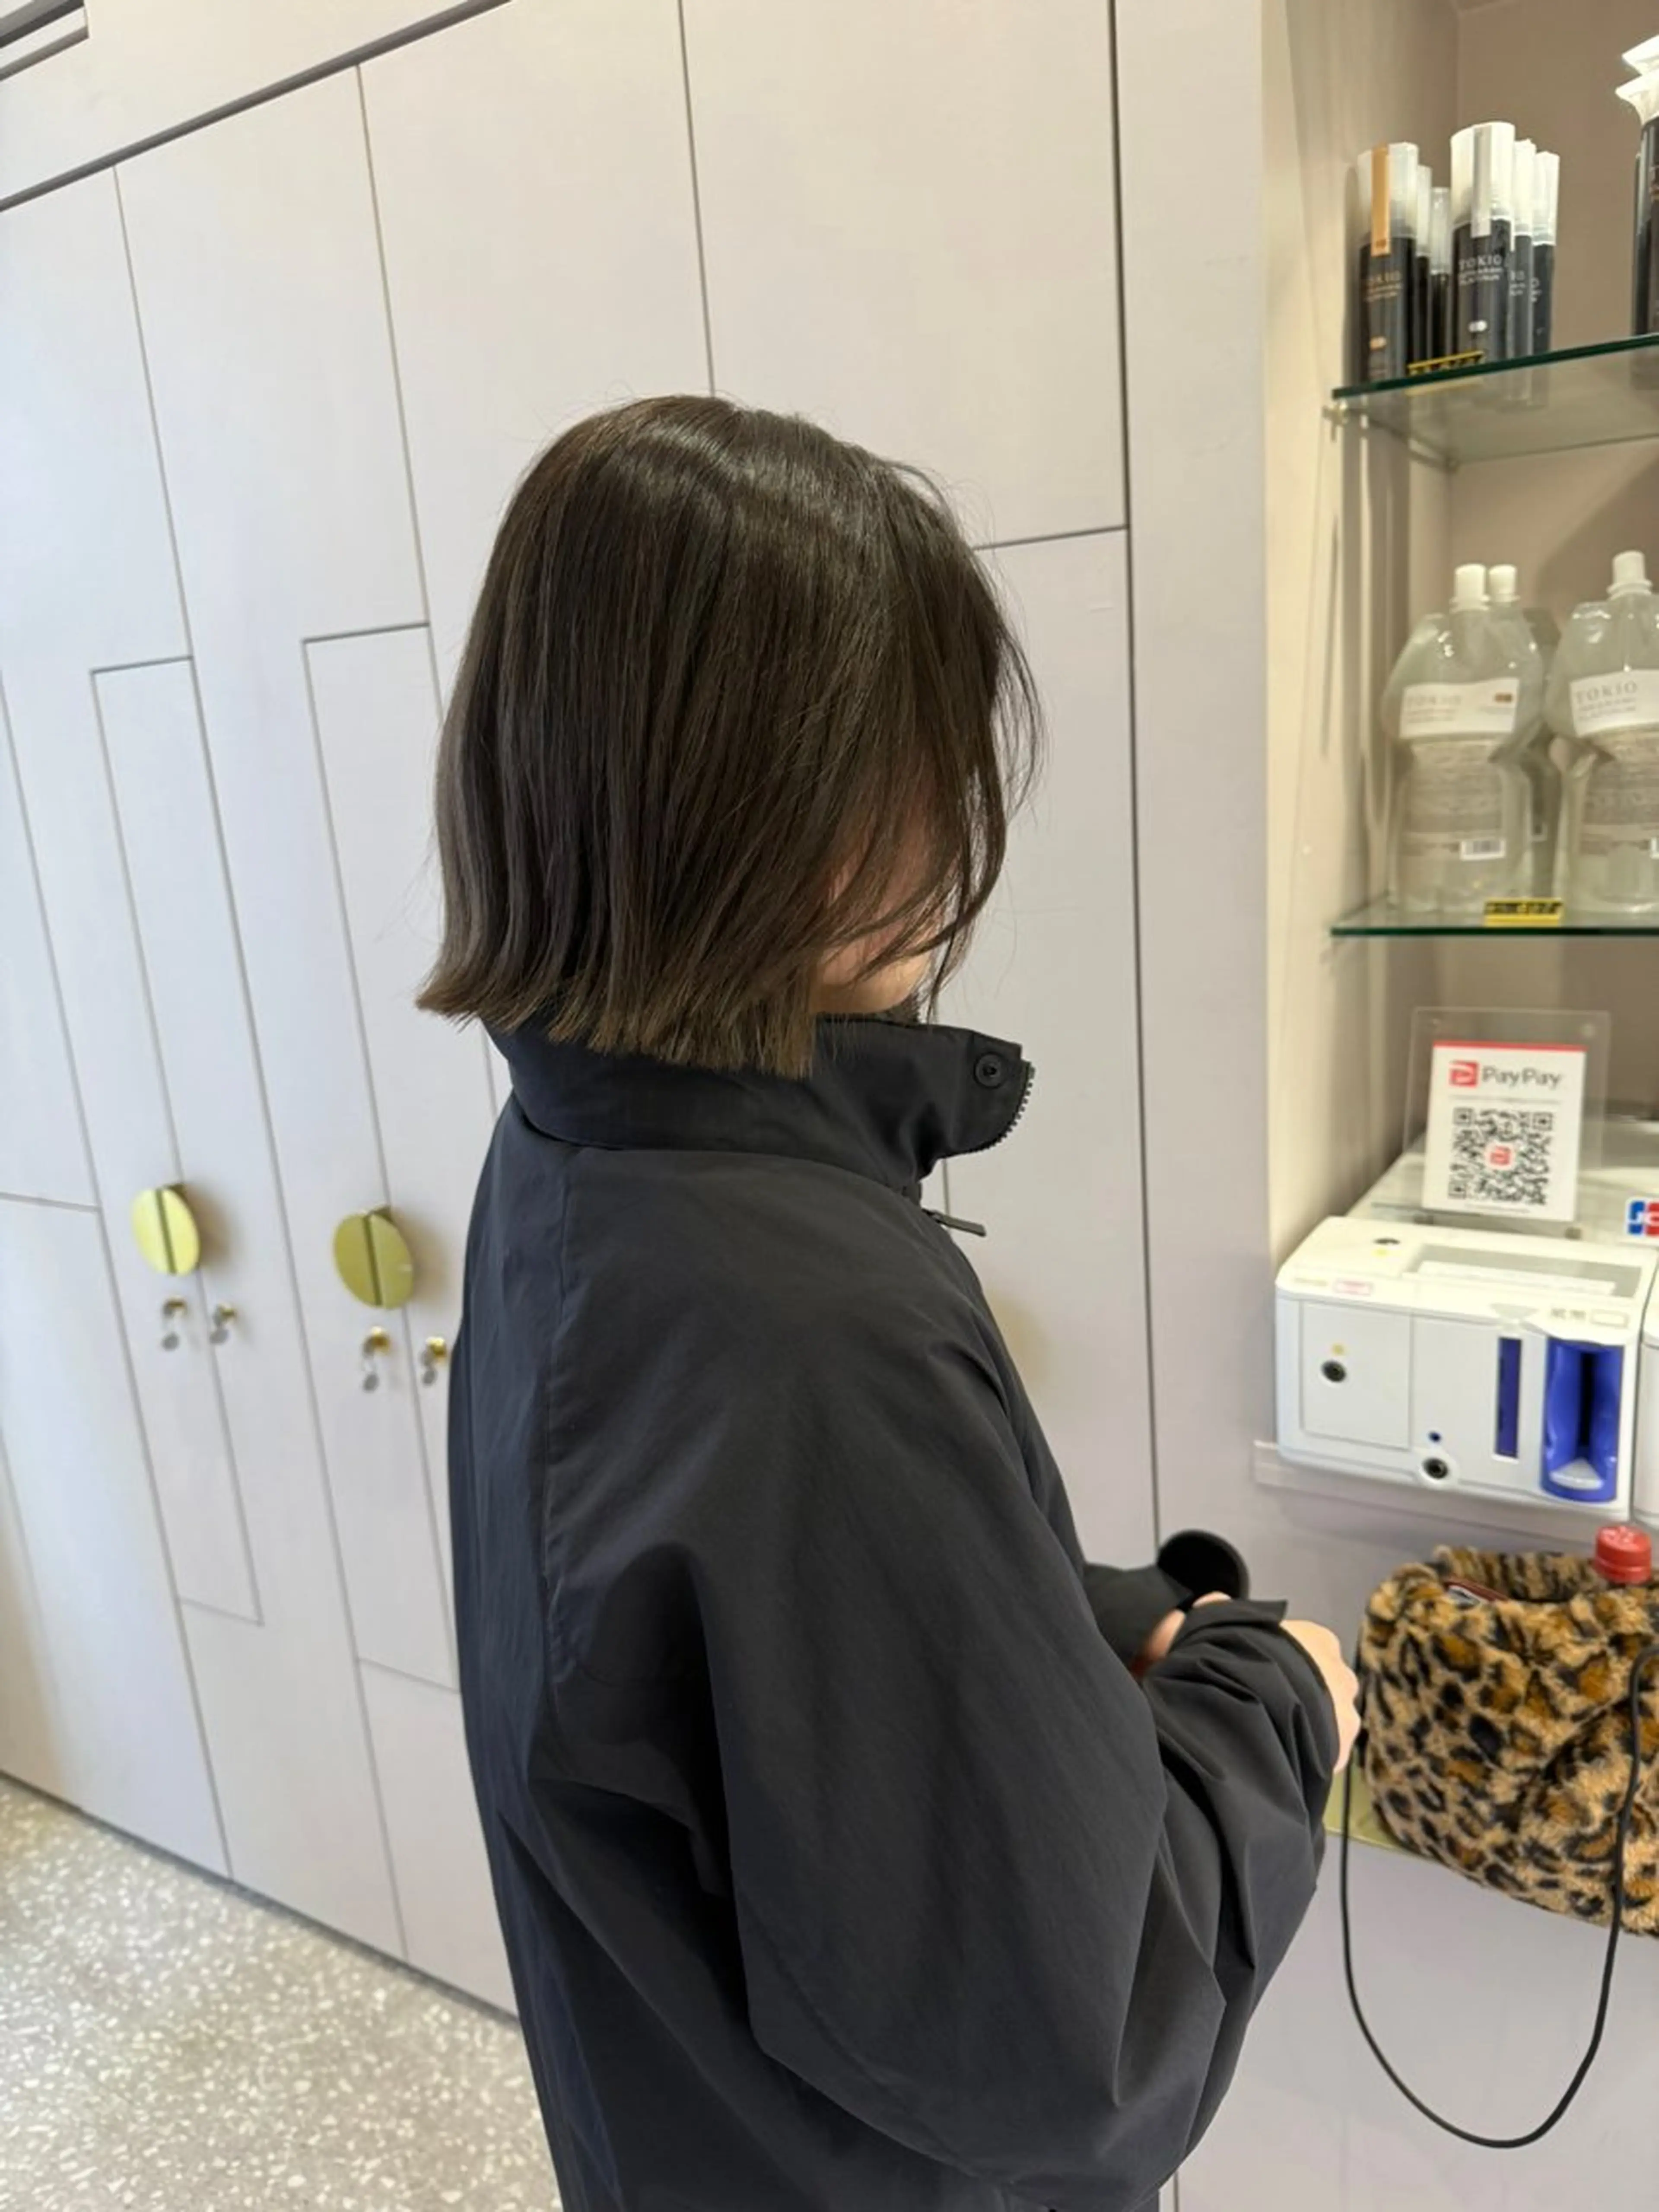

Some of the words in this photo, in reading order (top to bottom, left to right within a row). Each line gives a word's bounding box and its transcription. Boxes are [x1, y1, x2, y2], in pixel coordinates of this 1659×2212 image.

[1459, 254, 1503, 271] TOKIO
[1576, 680, 1638, 705] TOKIO
[1482, 1065, 1561, 1090] PayPay
